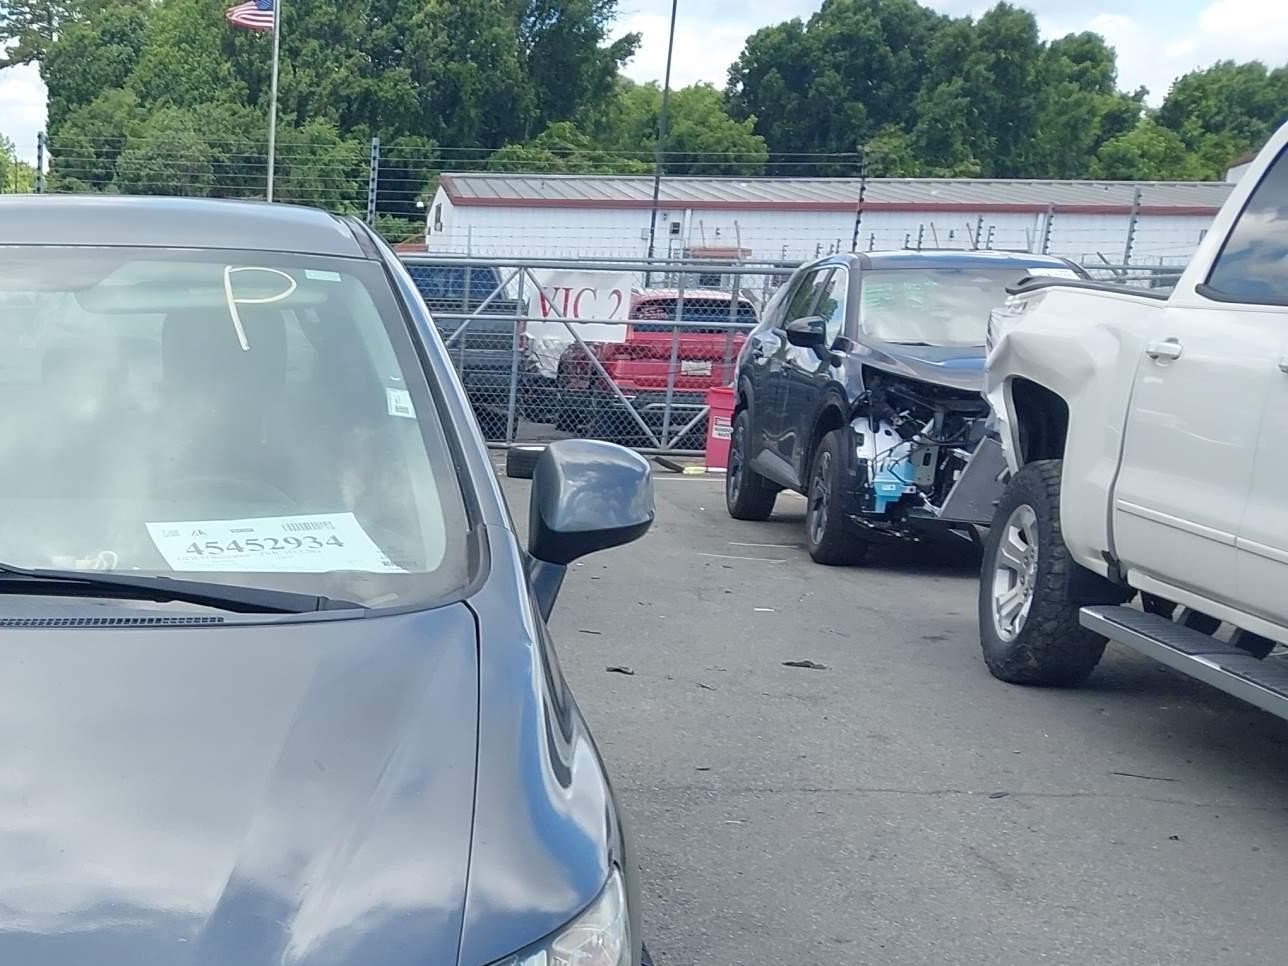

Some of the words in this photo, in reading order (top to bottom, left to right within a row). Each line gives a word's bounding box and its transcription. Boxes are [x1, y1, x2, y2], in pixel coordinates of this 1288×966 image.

[224, 265, 297, 352] P
[539, 286, 597, 319] VIC
[607, 288, 623, 320] 2
[186, 534, 345, 556] 45452934
